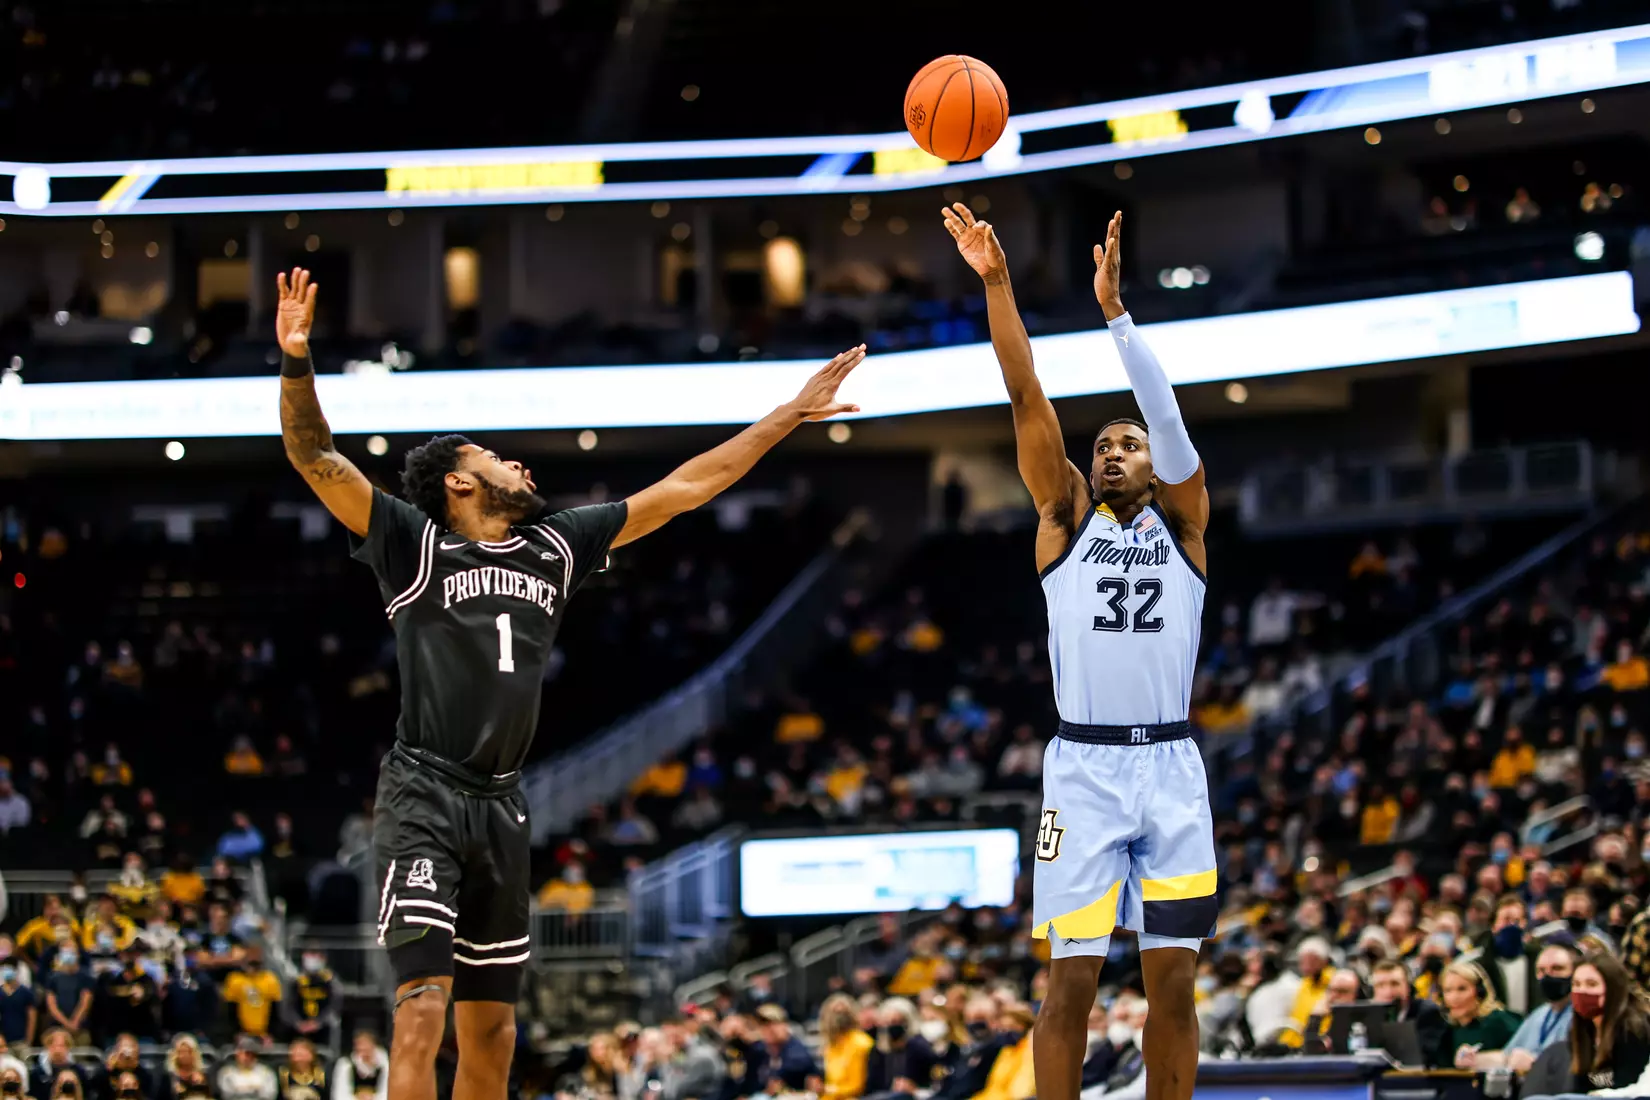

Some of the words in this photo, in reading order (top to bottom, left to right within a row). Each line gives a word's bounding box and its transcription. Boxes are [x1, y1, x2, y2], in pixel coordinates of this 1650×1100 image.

[1144, 525, 1157, 537] BIG
[1145, 527, 1163, 541] EAST
[1081, 537, 1170, 573] Marquette
[443, 566, 557, 616] PROVIDENCE
[1092, 577, 1164, 632] 32
[496, 613, 514, 672] 1
